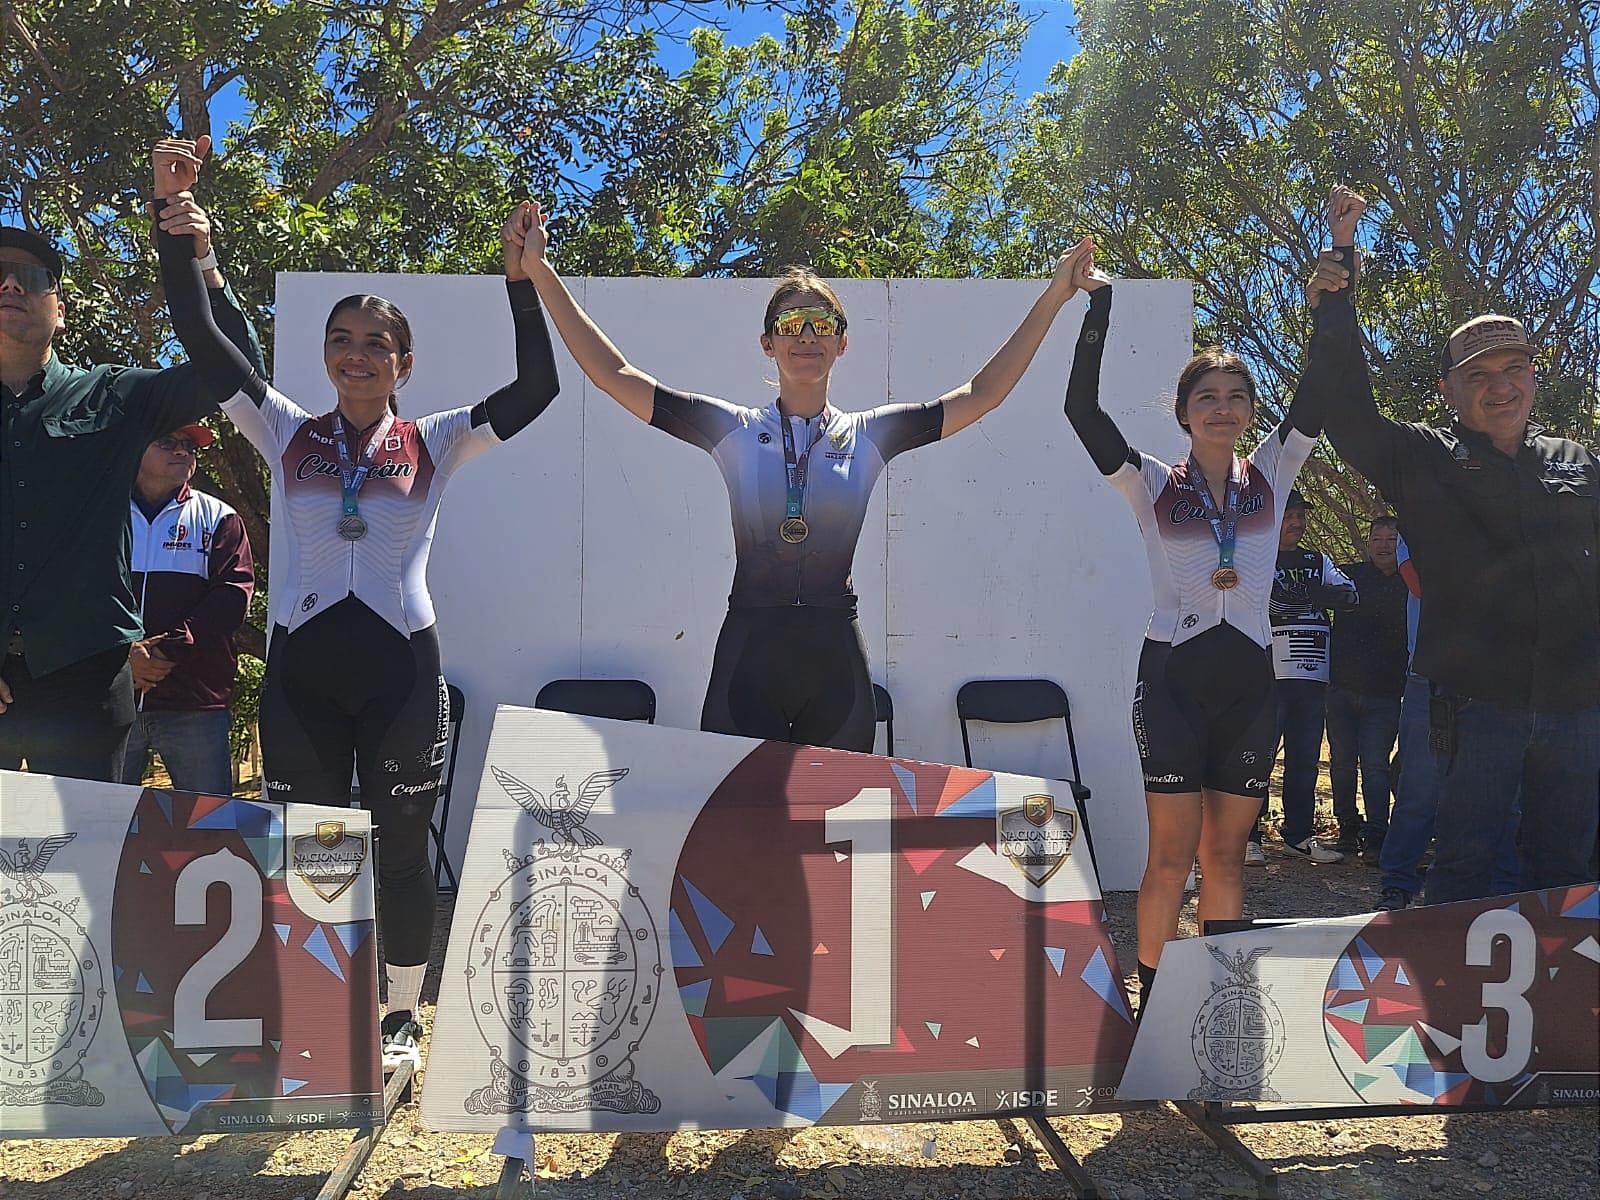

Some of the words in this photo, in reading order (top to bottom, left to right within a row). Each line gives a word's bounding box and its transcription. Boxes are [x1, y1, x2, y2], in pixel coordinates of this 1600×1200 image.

[1304, 568, 1319, 579] 74
[1001, 841, 1073, 857] CONADE
[526, 864, 609, 888] SINALOA
[824, 787, 893, 1045] 1
[174, 846, 263, 1049] 2
[1220, 987, 1261, 1000] SINALOA
[1460, 908, 1537, 1083] 3
[8, 1067, 46, 1079] 1831
[539, 1064, 588, 1079] 1831
[888, 1091, 977, 1110] SINALOA
[1012, 1089, 1058, 1107] ISDE
[218, 1113, 275, 1125] SINALOA
[296, 1113, 326, 1124] ISDE
